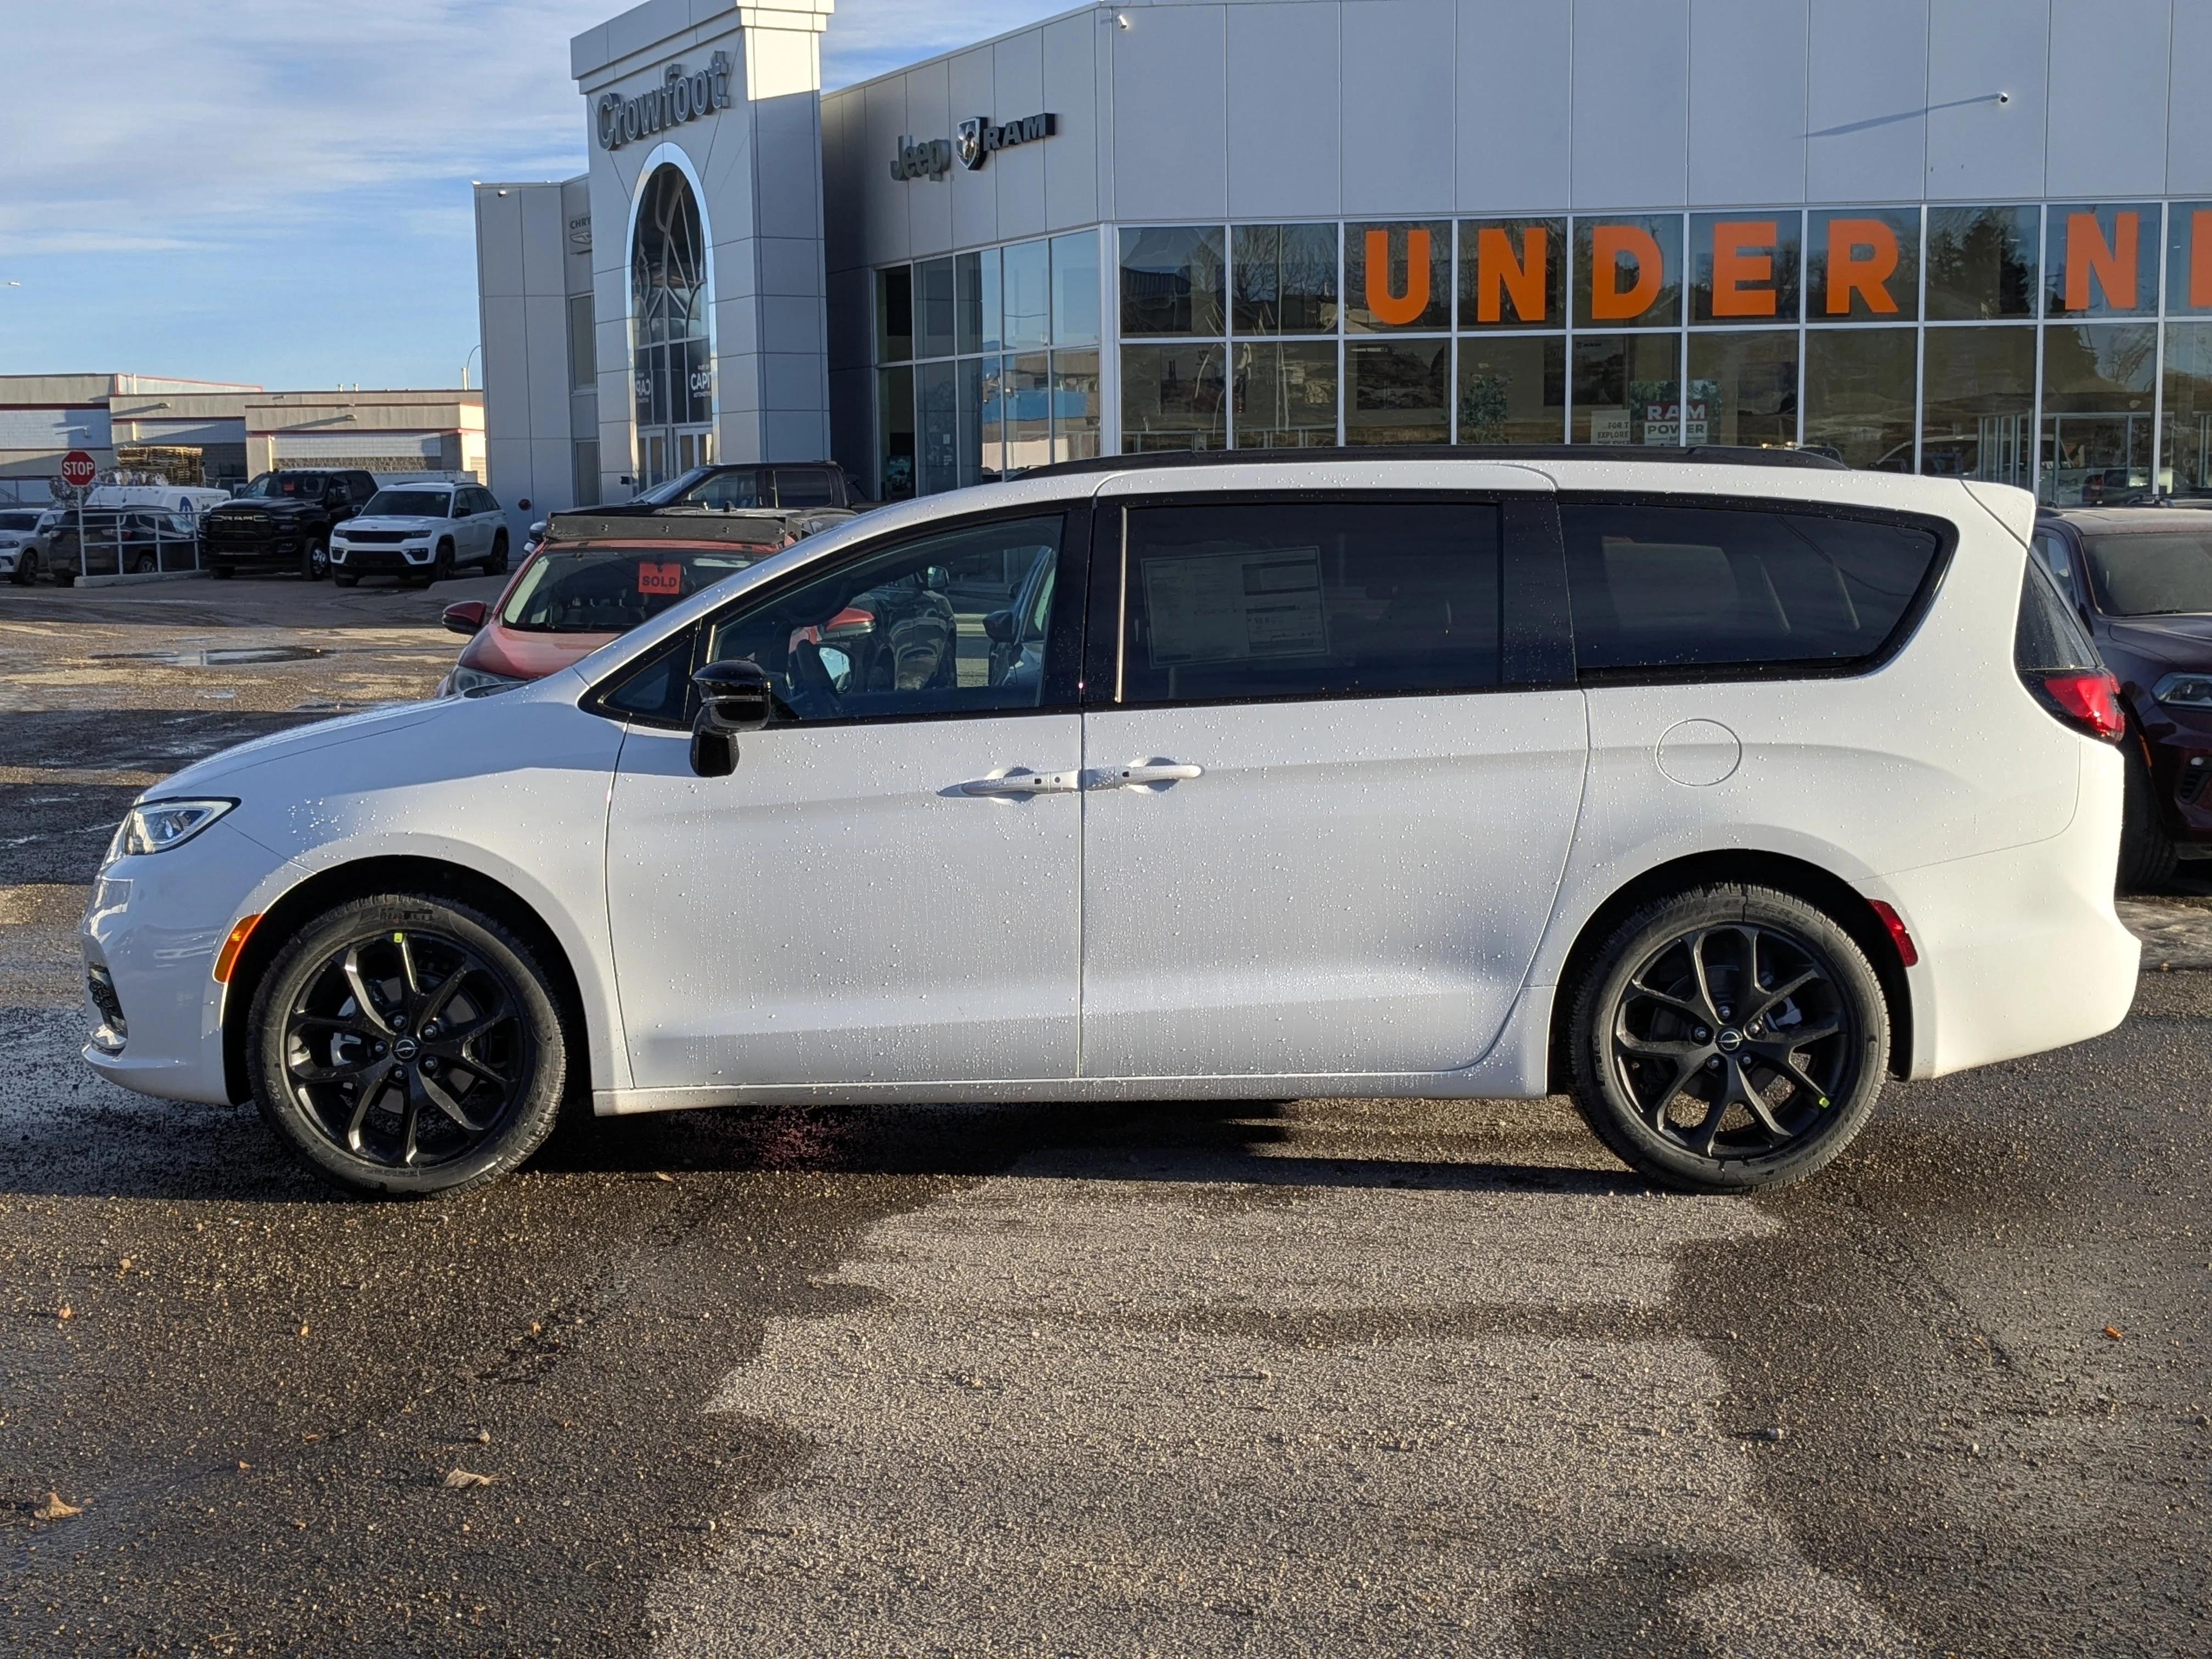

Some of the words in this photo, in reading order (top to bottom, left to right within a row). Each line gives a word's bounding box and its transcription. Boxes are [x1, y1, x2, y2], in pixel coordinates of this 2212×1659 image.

[597, 50, 730, 151] Crowfoot
[984, 113, 1052, 151] RAM
[890, 135, 949, 181] Jeep
[1365, 219, 1899, 325] UNDER
[1647, 404, 1705, 420] RAM
[1647, 424, 1705, 435] POWER
[63, 461, 94, 476] STOP
[642, 575, 677, 588] SOLD
